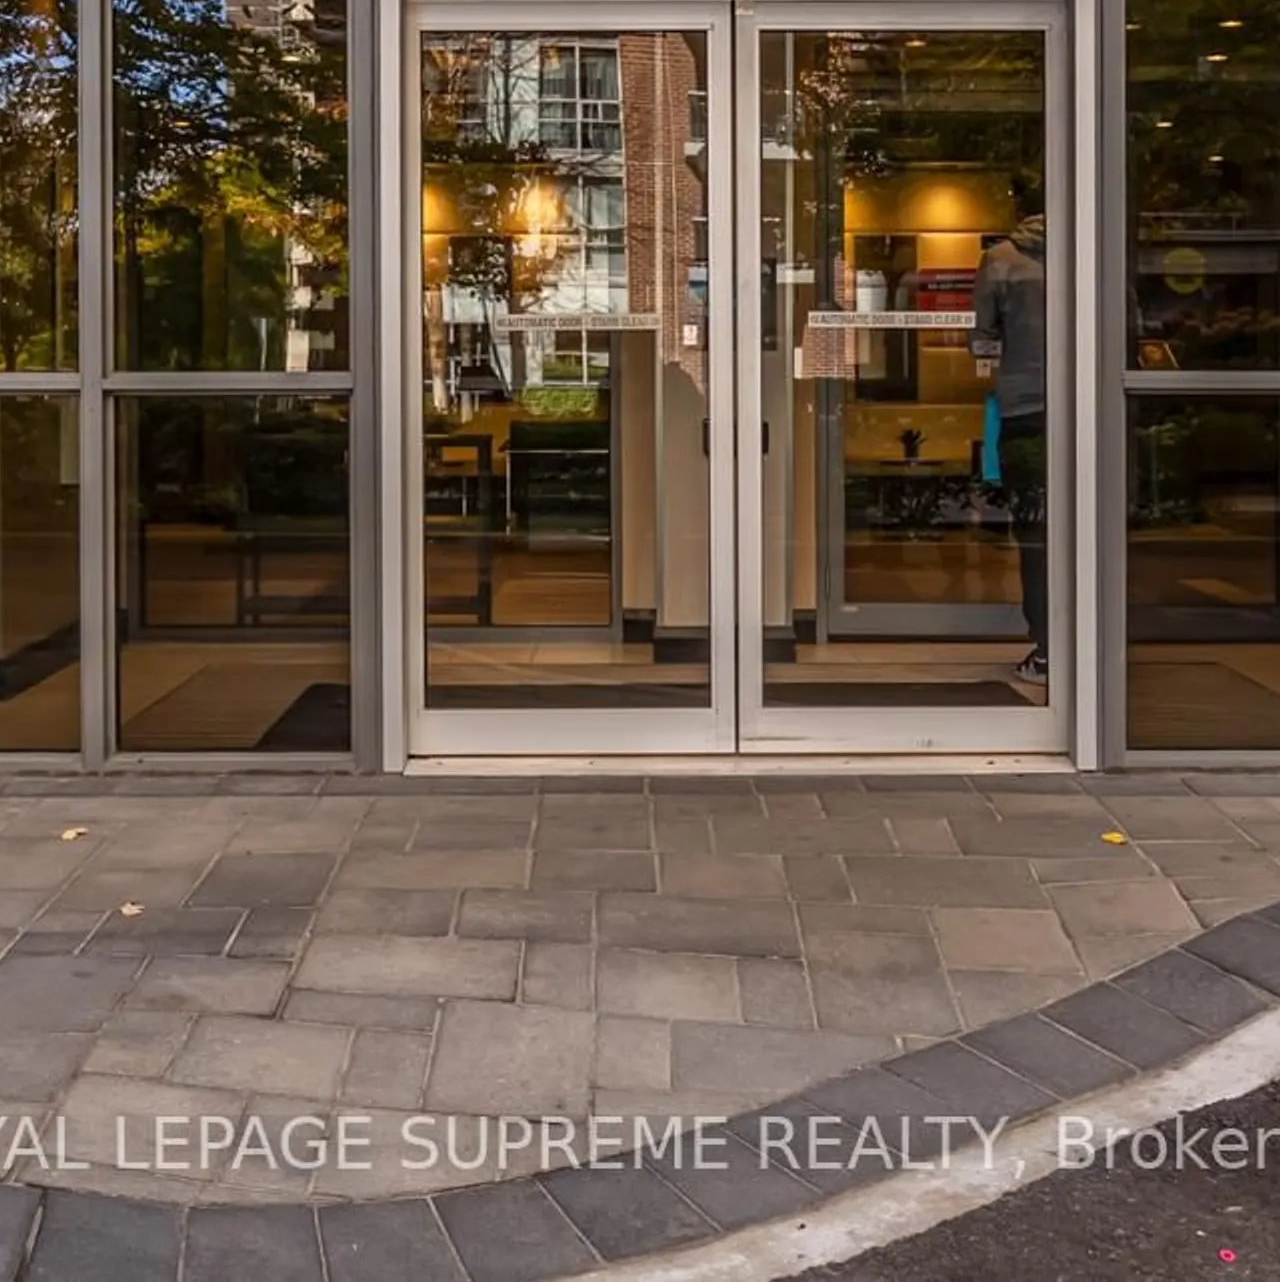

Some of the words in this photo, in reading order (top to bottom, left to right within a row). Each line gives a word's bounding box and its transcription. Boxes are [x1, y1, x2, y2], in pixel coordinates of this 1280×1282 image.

[508, 316, 557, 327] AUTOMATIC
[821, 314, 869, 324] AUTOMATIC
[904, 314, 932, 324] STAND
[934, 314, 962, 324] CLEAR
